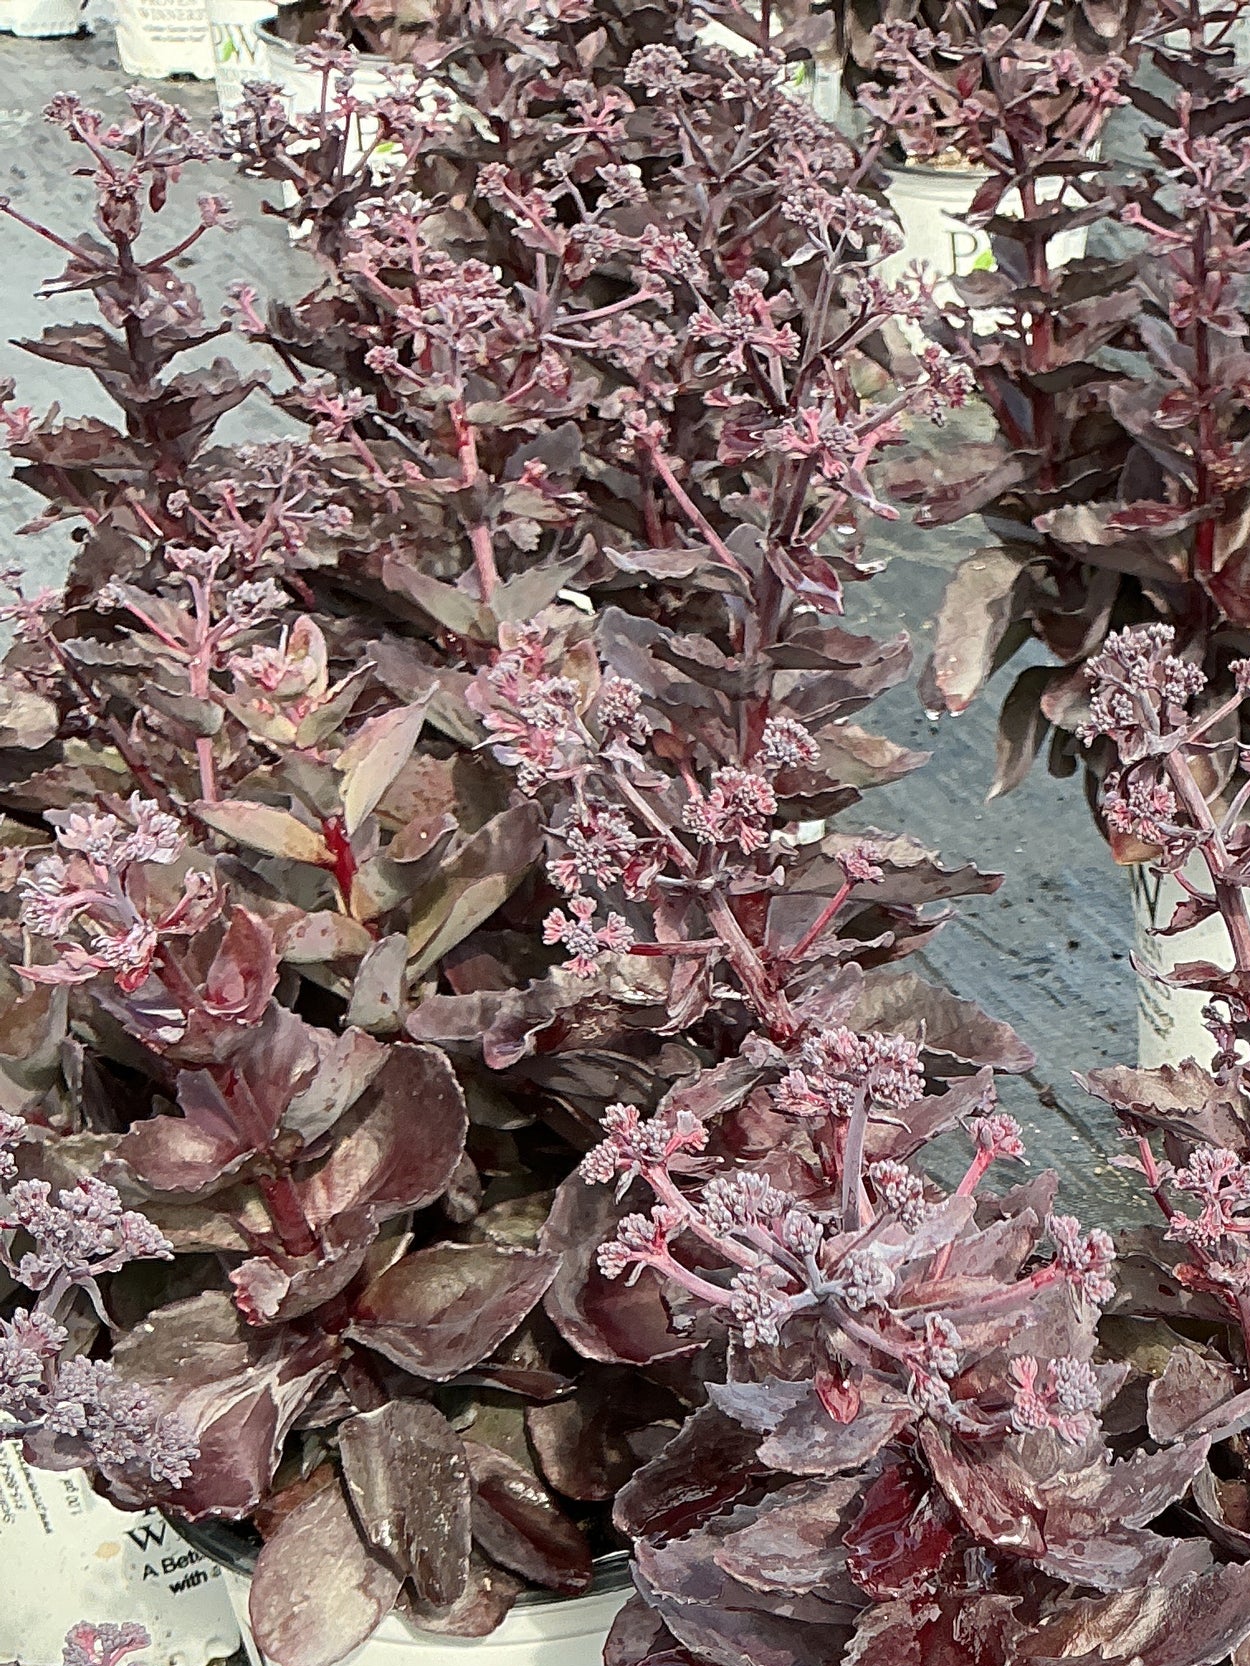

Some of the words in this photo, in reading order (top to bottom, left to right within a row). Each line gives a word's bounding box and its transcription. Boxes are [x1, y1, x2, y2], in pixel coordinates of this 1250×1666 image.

[143, 1563, 159, 1581] A
[161, 1551, 206, 1575] Bet
[169, 1570, 209, 1595] with
